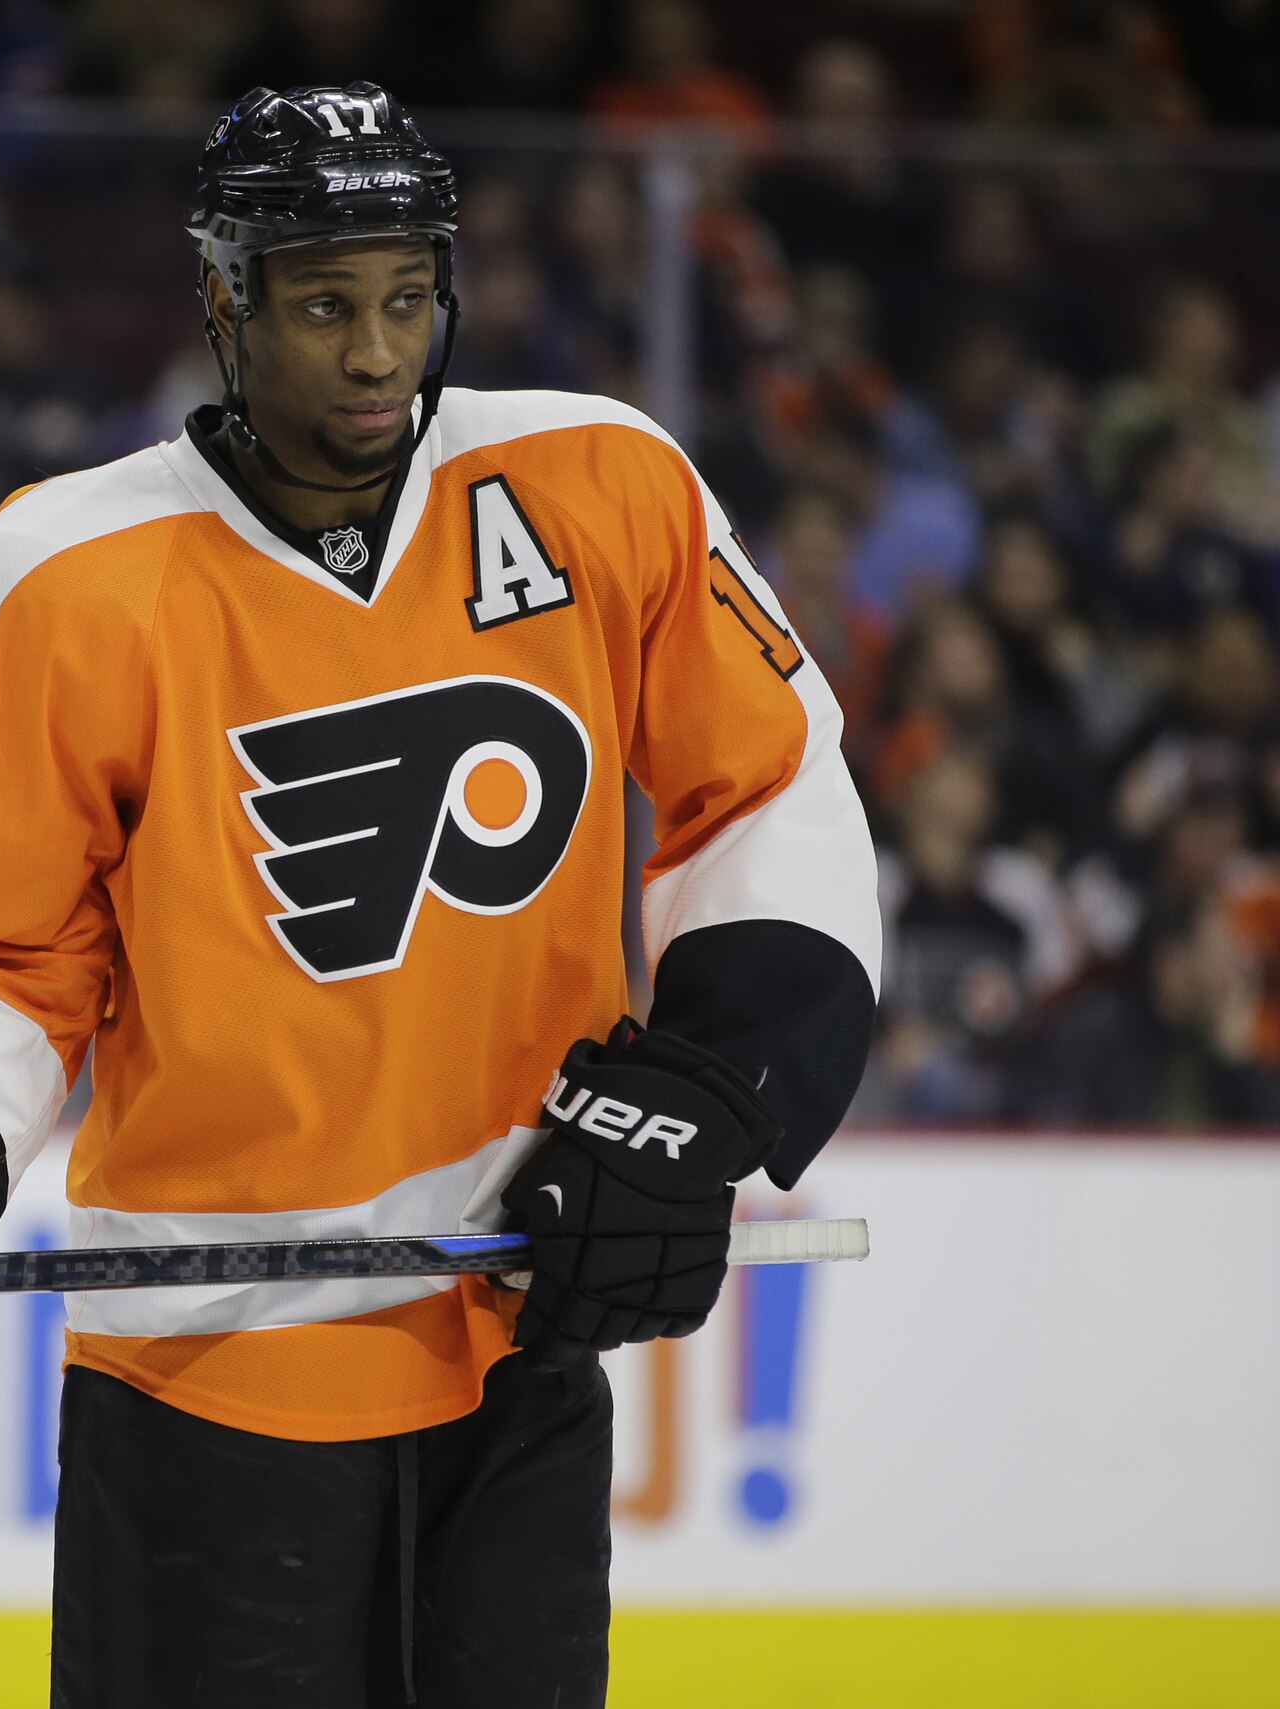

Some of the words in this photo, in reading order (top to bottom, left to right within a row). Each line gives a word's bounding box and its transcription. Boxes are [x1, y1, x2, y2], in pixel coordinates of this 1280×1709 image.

[317, 102, 381, 137] 17
[335, 538, 358, 566] NHL
[464, 473, 575, 633] A
[542, 1068, 698, 1160] UER
